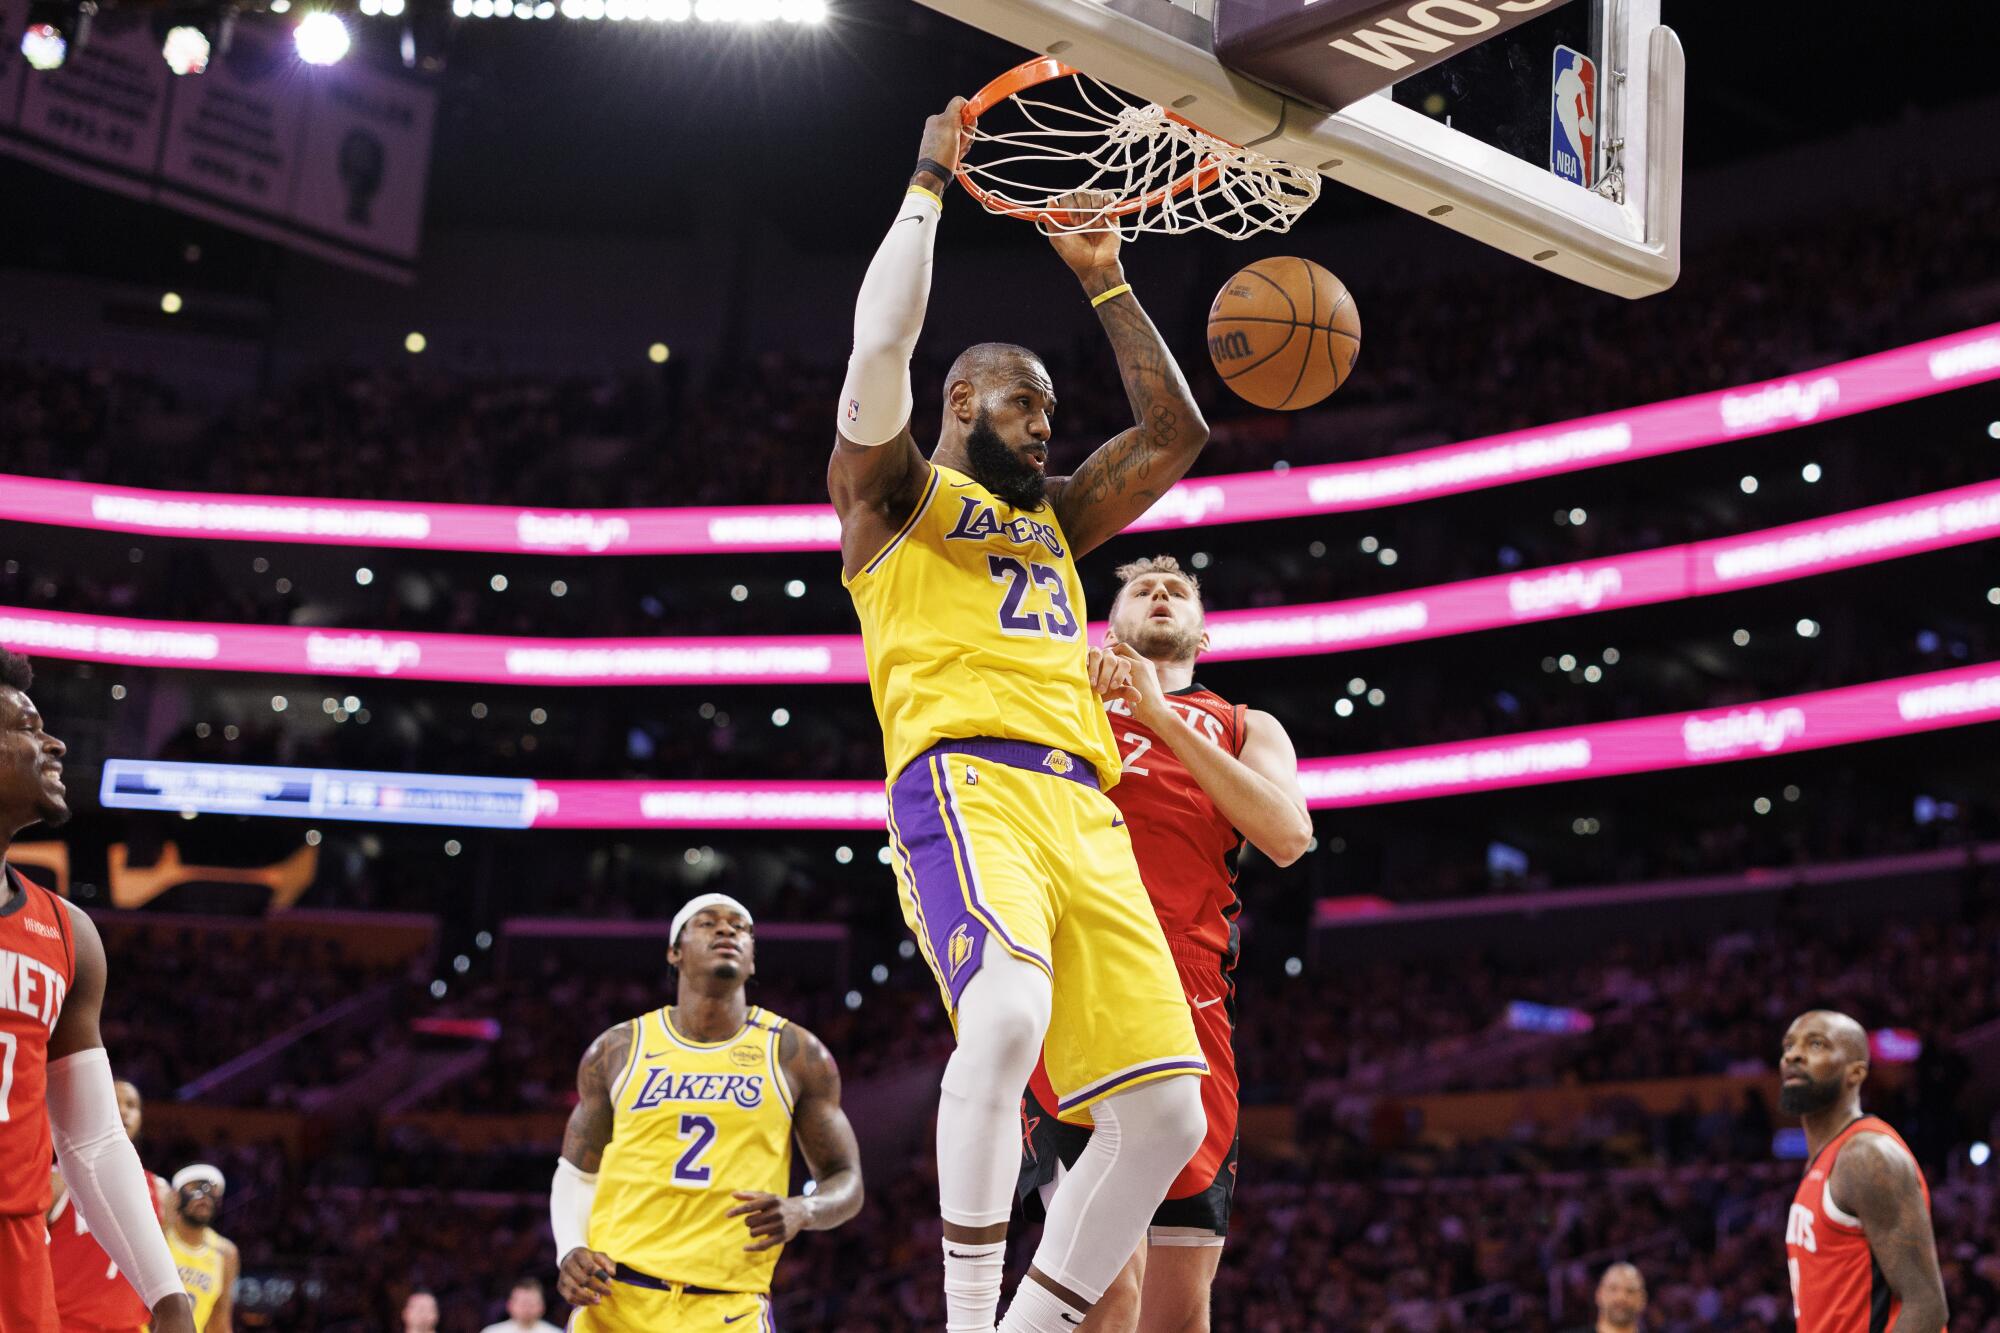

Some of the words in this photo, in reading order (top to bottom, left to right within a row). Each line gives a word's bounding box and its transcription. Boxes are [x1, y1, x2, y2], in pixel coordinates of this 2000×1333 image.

[1556, 150, 1577, 179] NBA
[987, 553, 1082, 643] 23
[630, 1067, 763, 1111] LAKERS
[671, 1113, 717, 1189] 2
